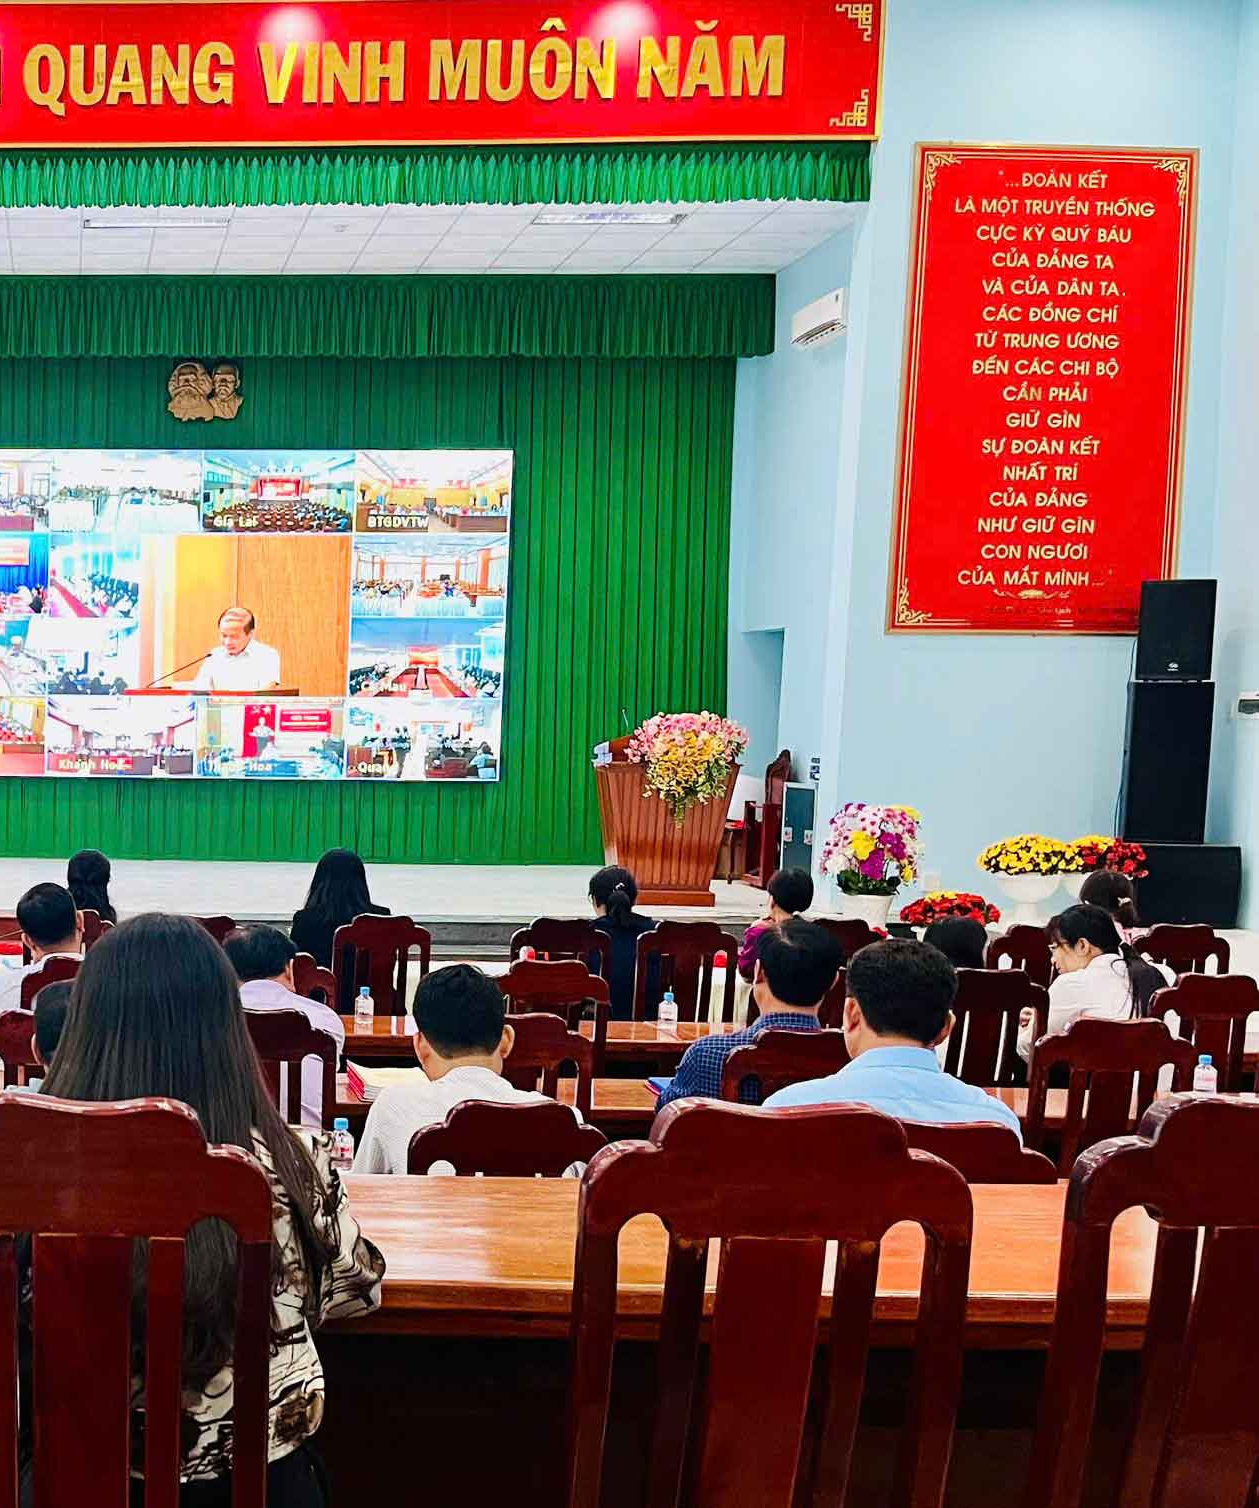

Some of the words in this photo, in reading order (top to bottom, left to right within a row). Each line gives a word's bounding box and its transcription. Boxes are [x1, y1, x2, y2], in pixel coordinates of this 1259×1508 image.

[23, 43, 234, 116] QUANG
[256, 40, 405, 104] VINH
[428, 19, 616, 101] MUÔN
[637, 19, 786, 98] NĂM
[1078, 170, 1108, 188] KẾT
[955, 196, 976, 213] LÀ
[981, 196, 1019, 216] MỘT
[1024, 196, 1089, 215] TRUYỀN
[1095, 197, 1156, 216] THỐNG
[976, 224, 1017, 243] CỰC
[1022, 224, 1046, 240] KỲ
[1051, 225, 1091, 242] QUÝ
[1097, 225, 1132, 242] BÁU
[992, 248, 1030, 267] CỦA
[1036, 248, 1089, 268] ĐẢNG
[1094, 255, 1114, 268] TA
[982, 277, 1005, 294] VÀ
[1010, 275, 1050, 294] CỦA
[1057, 278, 1094, 295] DÂN
[982, 304, 1022, 321] CÁC
[1028, 303, 1082, 322] ĐỒNG
[1086, 305, 1118, 322] CHÍ
[975, 330, 998, 347] TỪ
[1002, 334, 1060, 348] TRUNG
[1066, 332, 1120, 349] ƯƠNG
[972, 355, 1009, 374] ĐẾN
[1014, 358, 1054, 374] CÁC
[1059, 361, 1090, 375] CHI
[1095, 358, 1119, 378] BỘ
[1002, 382, 1042, 400] CẦN
[1048, 382, 1088, 401] PHẢI
[1005, 410, 1041, 427] GIỮ
[1046, 410, 1081, 427] GÌN
[981, 438, 1006, 456] SỰ
[1011, 437, 1064, 454] ĐOÀN
[1069, 436, 1101, 454] KẾT
[1003, 462, 1048, 480] NHẤT
[1054, 463, 1078, 480] TRÍ
[989, 487, 1028, 506] CỦA
[1035, 487, 1088, 507] ĐẢNG
[977, 516, 1018, 533] NHƯ
[1022, 516, 1056, 532] GIỮ
[1060, 517, 1095, 534] GÌN
[980, 545, 1022, 559] CON
[957, 565, 995, 584] CỦA
[1003, 565, 1039, 586] MẮT
